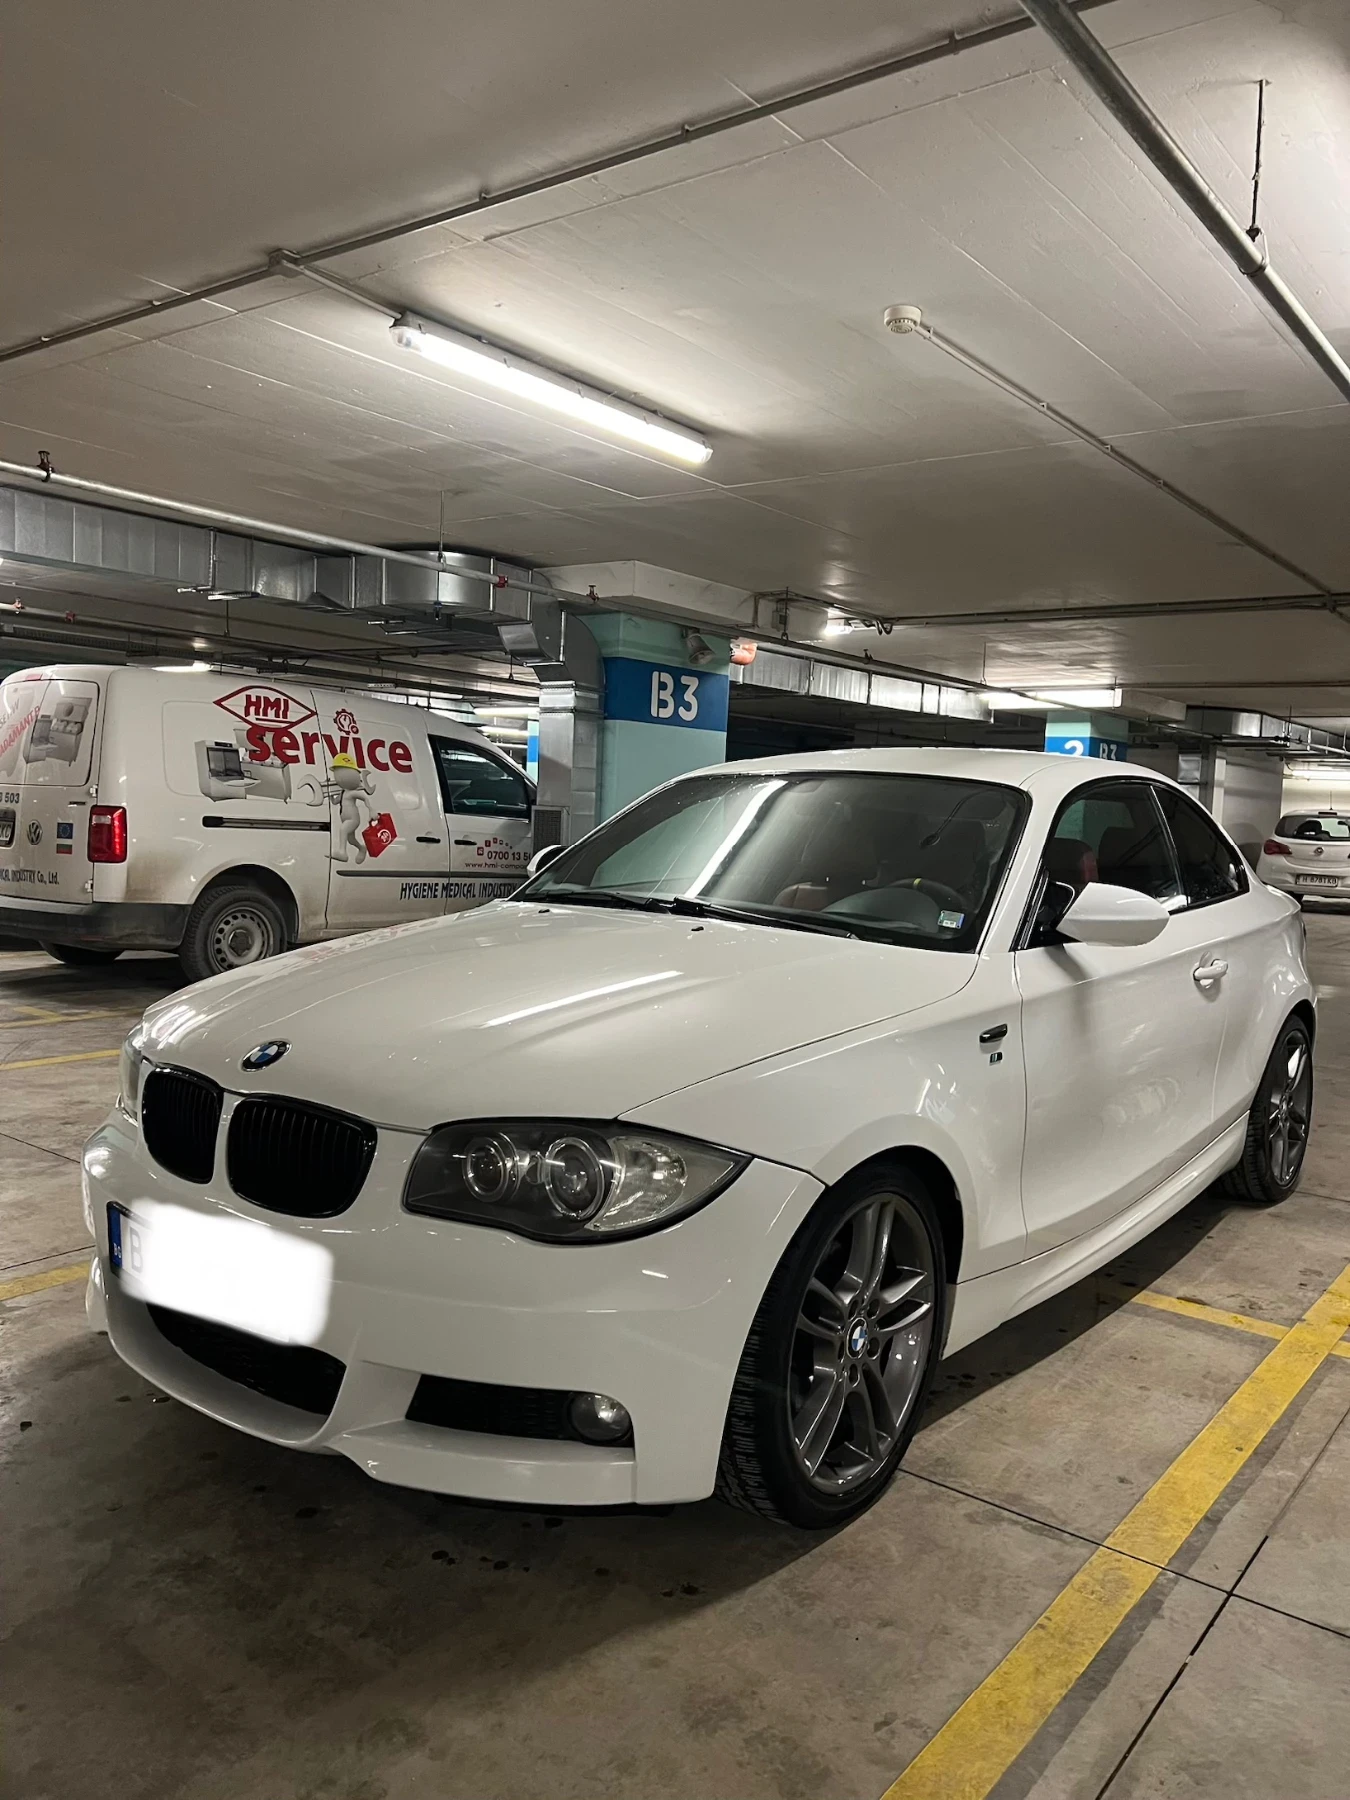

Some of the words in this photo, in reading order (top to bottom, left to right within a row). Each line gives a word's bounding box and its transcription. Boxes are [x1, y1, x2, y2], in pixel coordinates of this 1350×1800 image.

[244, 694, 290, 719] HMI
[650, 670, 699, 722] B3
[487, 850, 509, 861] 0700
[511, 851, 521, 861] 13
[400, 882, 439, 900] HYGIENE
[440, 882, 476, 899] MEDICAL
